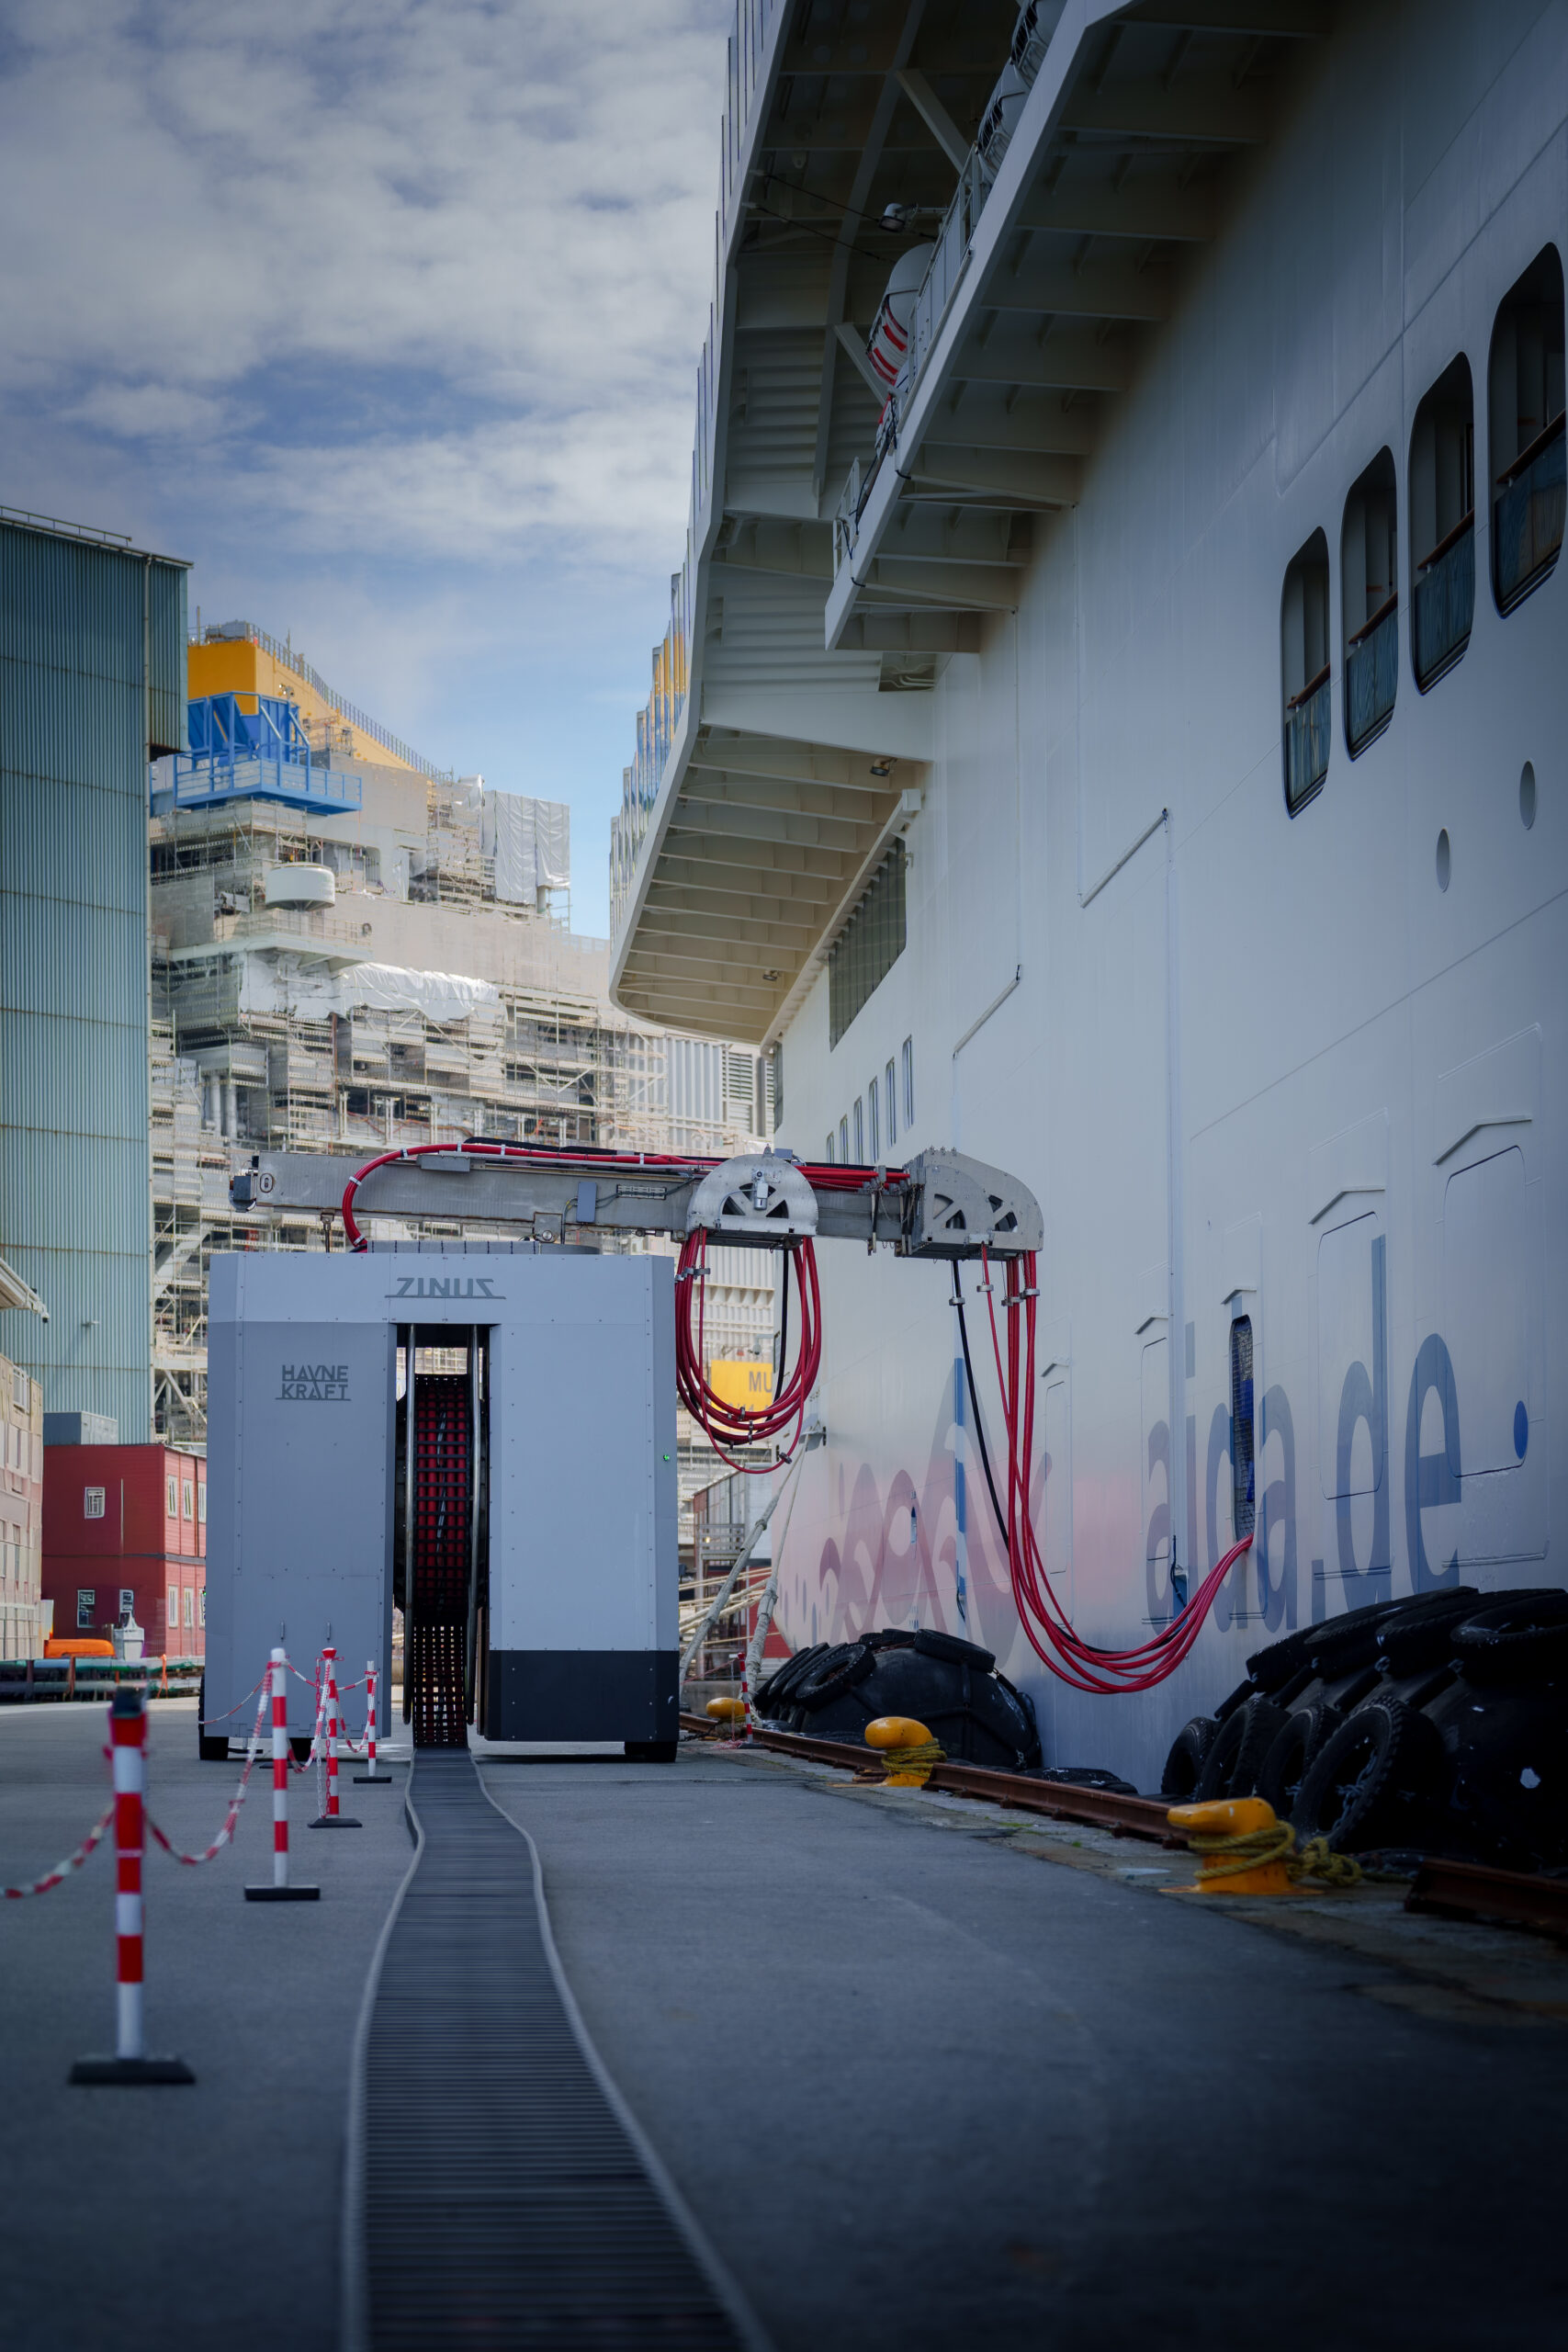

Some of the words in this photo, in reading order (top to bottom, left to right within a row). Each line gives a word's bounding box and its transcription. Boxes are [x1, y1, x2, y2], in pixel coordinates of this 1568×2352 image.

[281, 1364, 348, 1382] HAVNE
[281, 1384, 348, 1399] KRAFT
[1146, 1234, 1463, 1634] aida.de
